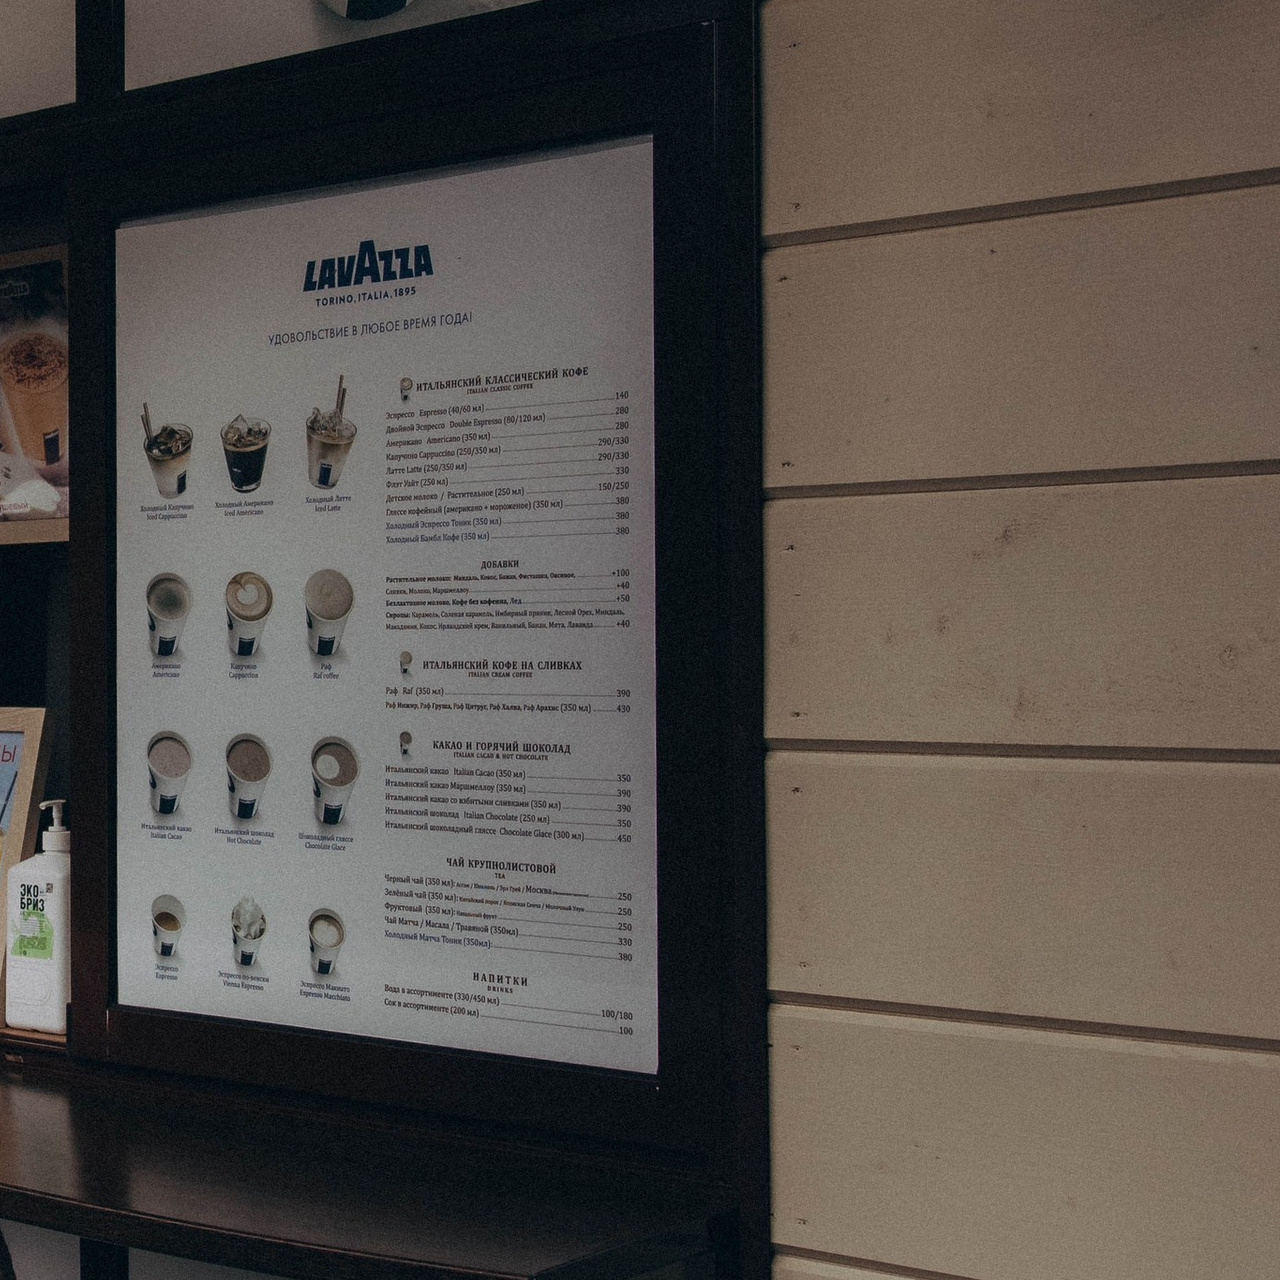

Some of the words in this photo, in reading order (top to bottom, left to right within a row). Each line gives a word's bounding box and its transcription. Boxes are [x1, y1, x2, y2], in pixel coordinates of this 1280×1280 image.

[302, 239, 434, 292] LAVAZZA
[393, 285, 416, 297] 1895
[267, 325, 348, 347] УДОВОЛЬСТВИЕ
[352, 324, 357, 336] В
[360, 319, 400, 336] ЛЮБОЕ
[403, 315, 436, 330] ВРЕМЯ
[439, 311, 472, 326] ГОДА!
[416, 374, 481, 392] ИТАЛЬЯНСКИЙ
[485, 367, 558, 385] КЛАССИЧЕСКИЙ
[562, 366, 588, 378] КОФЕ
[489, 384, 511, 392] CLASSIC
[512, 382, 533, 391] COFFEE
[385, 411, 415, 421] Эспрессо
[418, 408, 447, 418] Espresso
[472, 403, 484, 413] мл)
[615, 390, 629, 400] 140
[385, 423, 414, 434] Двойной
[415, 422, 445, 432] Эспрессо
[449, 418, 472, 428] Double
[473, 418, 502, 428] Espresso
[532, 412, 545, 422] мл)
[614, 405, 629, 415] 280
[426, 435, 461, 444] Americano
[478, 431, 491, 441] мл)
[615, 420, 629, 430] 280
[419, 449, 455, 460] Cappuccino
[488, 444, 501, 455] мл)
[597, 435, 629, 447] 290/330
[447, 490, 493, 499] Растительное
[494, 487, 510, 498] (250
[511, 486, 524, 497] мл)
[598, 481, 629, 492] 150/250
[480, 559, 519, 570] ДОБАВКИ
[422, 658, 488, 670] ИТАЛЬЯНСКИЙ
[492, 660, 517, 670] КОФЕ
[520, 660, 534, 670] НА
[537, 660, 582, 670] СЛИВКАХ
[385, 686, 398, 697] Раф
[402, 686, 414, 695] Raf
[415, 686, 431, 696] (350
[431, 687, 444, 697] мл)
[616, 688, 630, 697] 390
[432, 740, 462, 750] КАКАО
[465, 741, 472, 750] И
[475, 740, 519, 752] ГОРЯЧИЙ
[522, 743, 571, 755] ШОКОЛАД
[385, 764, 428, 774] Итальянский
[453, 767, 474, 776] Italian
[474, 768, 494, 777] Cacao
[495, 768, 512, 779] (350
[513, 769, 526, 780] мл)
[616, 773, 631, 782] 350
[385, 778, 428, 788] Итальянский
[496, 783, 512, 793] (350
[513, 784, 526, 794] мл)
[616, 788, 631, 798] 390
[385, 806, 428, 816] Итальянский
[463, 810, 484, 820] Italian
[485, 811, 518, 821] Chocolate
[519, 813, 536, 823] (250
[537, 814, 550, 825] мл)
[616, 818, 631, 828] 350
[446, 856, 464, 867] ЧАЙ
[467, 858, 556, 874] КРУПНОЛИСТОВОЙ
[20, 883, 39, 898] ЭКО
[20, 897, 45, 912] БРИЗ
[384, 915, 397, 924] Чай
[398, 916, 419, 926] Матча
[425, 919, 450, 930] Масала
[455, 922, 489, 933] Травяной
[617, 937, 632, 946] 330
[384, 929, 418, 940] Холодный
[419, 932, 440, 942] Матча
[440, 934, 462, 945] Тоник
[617, 952, 633, 962] 380
[472, 971, 527, 986] НАПИТКИ
[486, 985, 513, 994] DRINKS
[384, 983, 400, 994] Вода
[406, 988, 453, 999] ассортименте
[453, 992, 485, 1003] (330/450
[487, 996, 500, 1006] мл)
[601, 1009, 633, 1020] 100/180
[383, 997, 396, 1006] Сок
[402, 1001, 449, 1013] ассортименте
[449, 1005, 466, 1016] (200
[466, 1008, 479, 1019] мл)
[618, 1026, 633, 1035] 100
